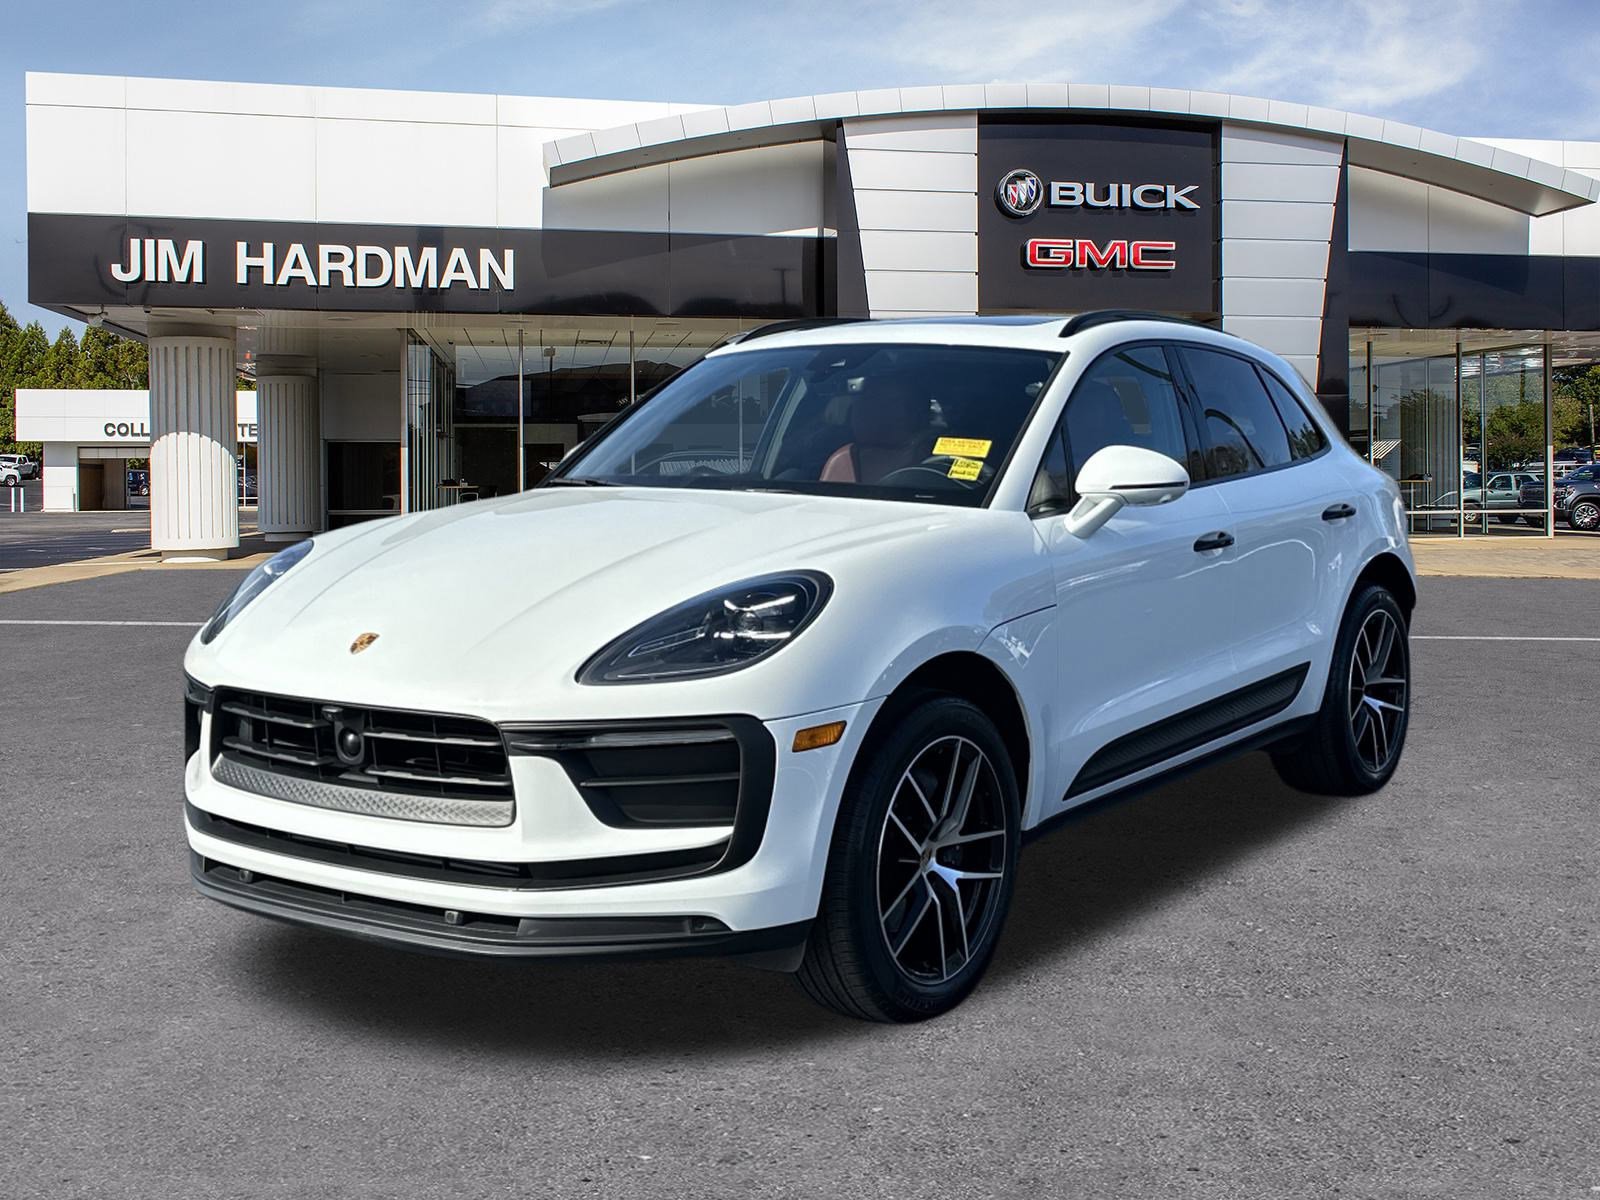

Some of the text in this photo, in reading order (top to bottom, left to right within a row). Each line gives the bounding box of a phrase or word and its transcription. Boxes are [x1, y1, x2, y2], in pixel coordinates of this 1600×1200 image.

[1050, 181, 1200, 209] BUICK
[111, 238, 515, 290] JIM HARDMAN
[1027, 239, 1176, 270] GMC
